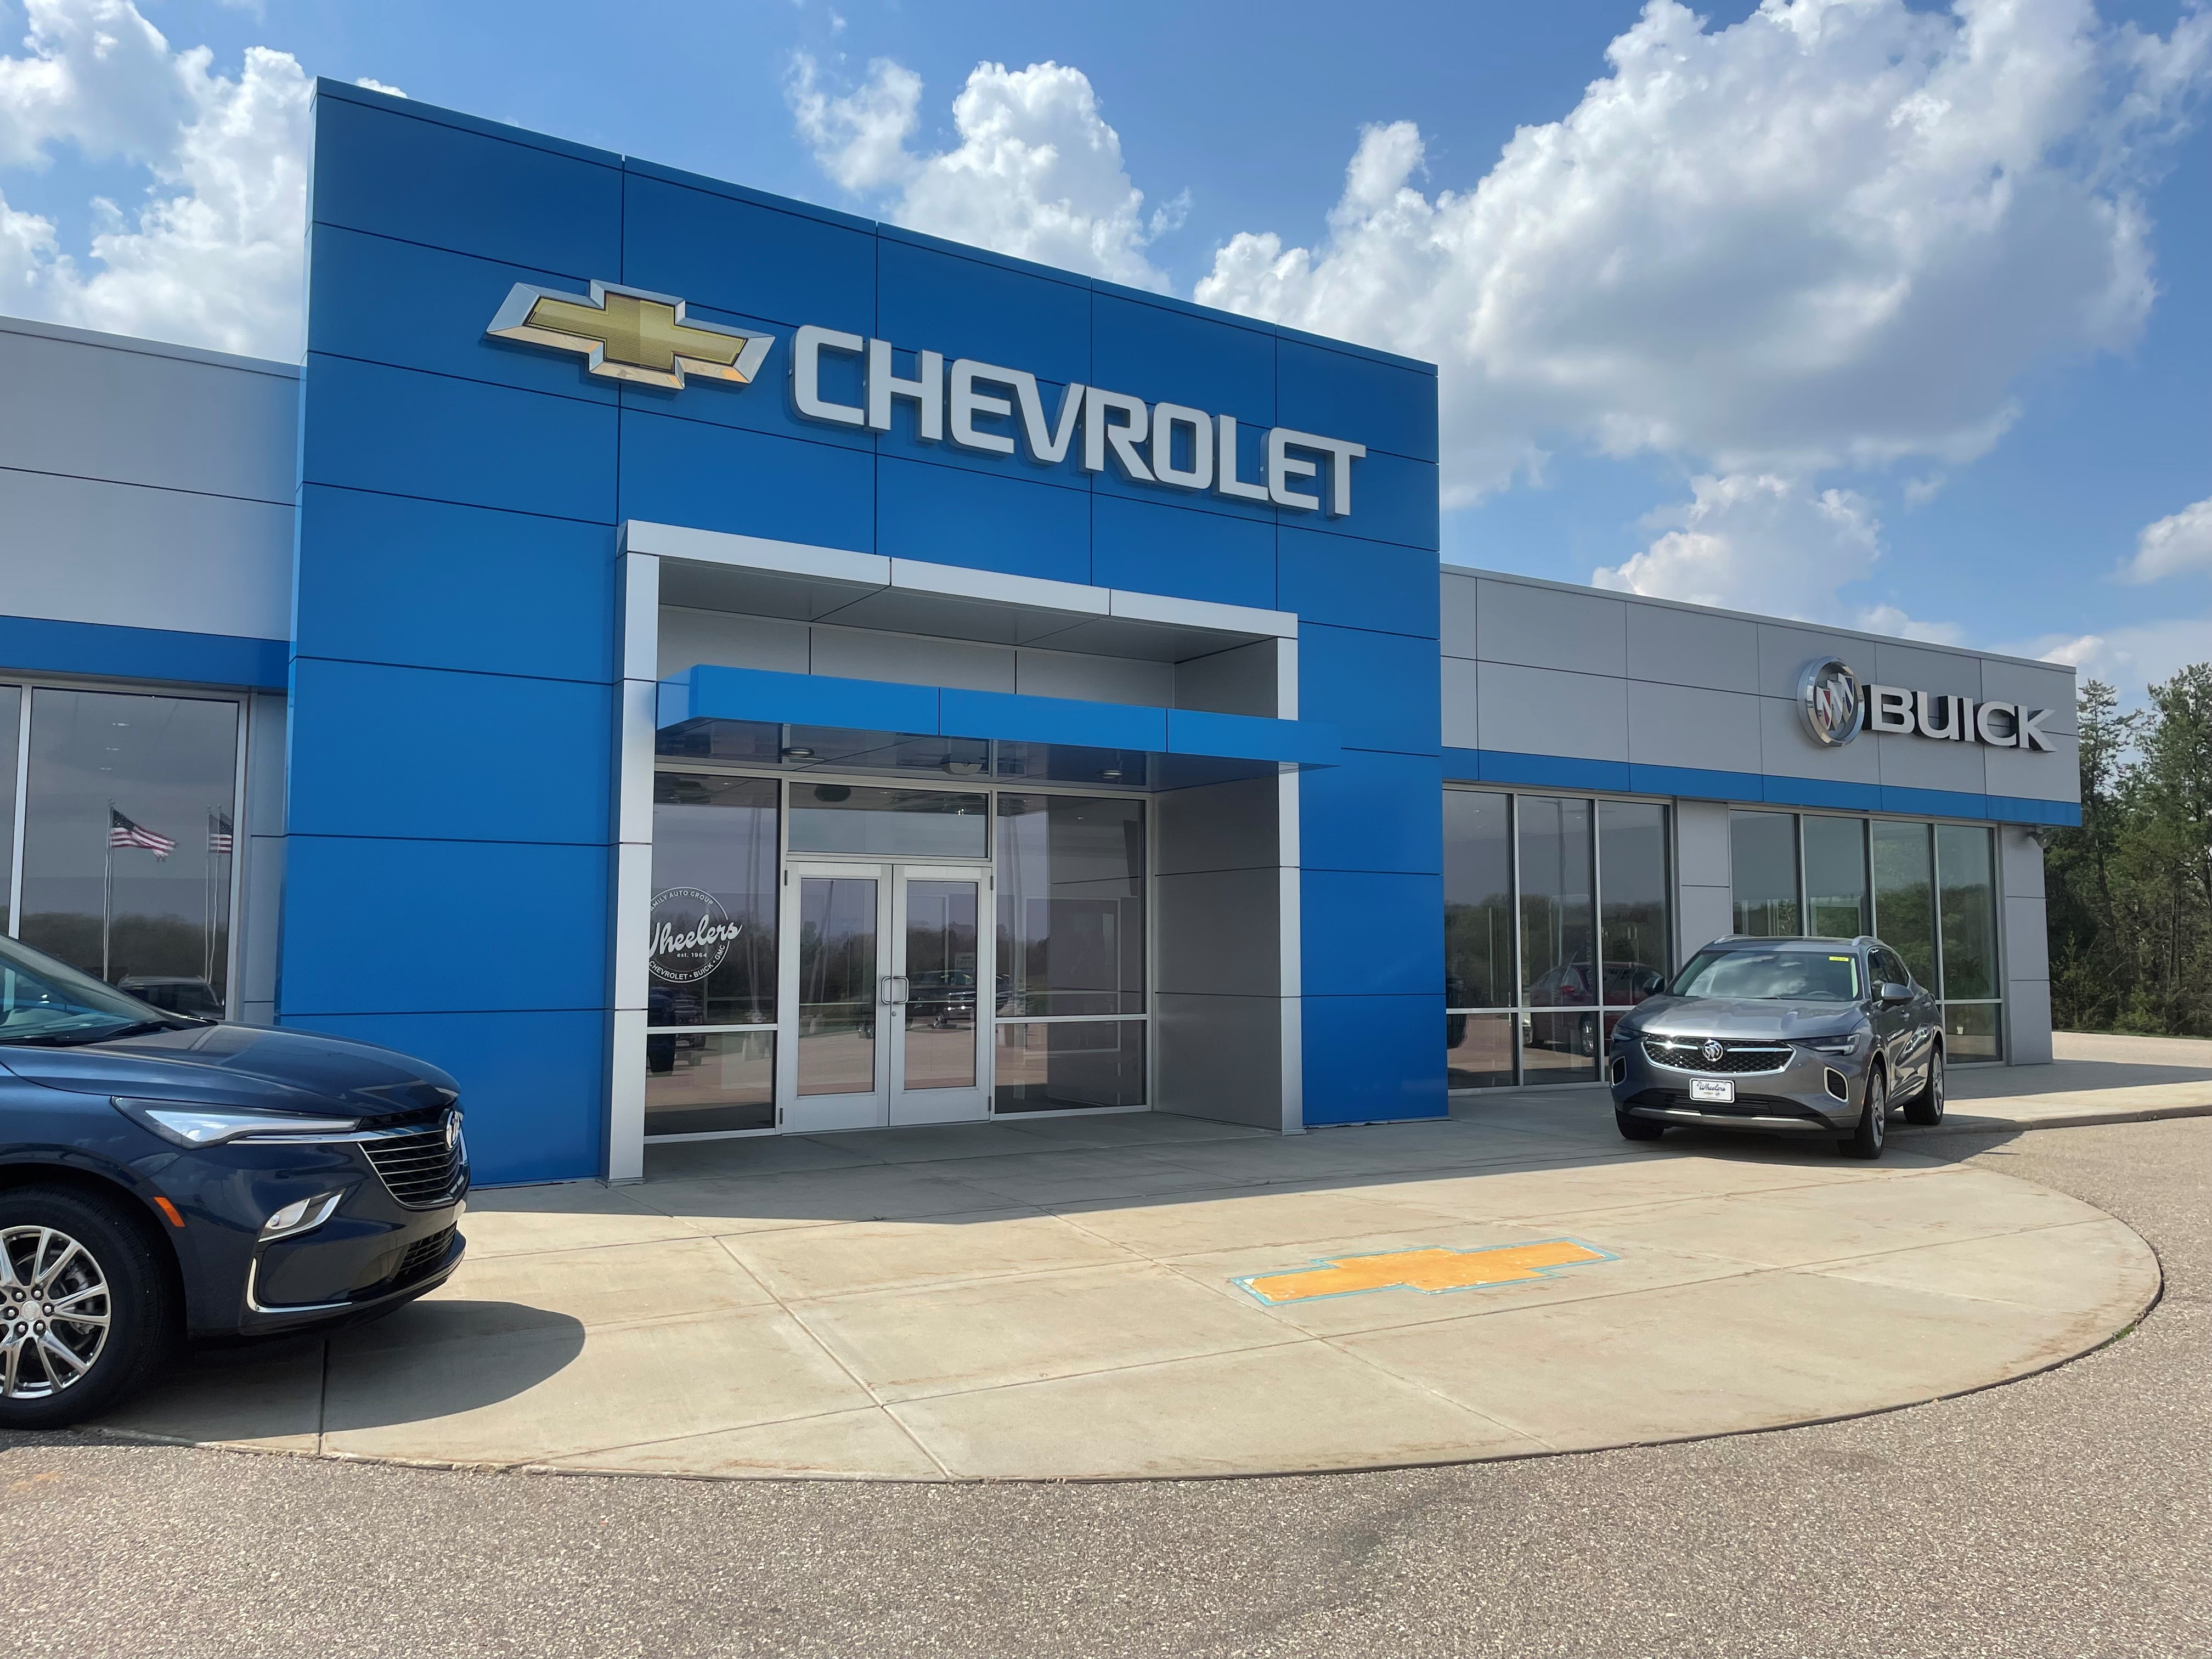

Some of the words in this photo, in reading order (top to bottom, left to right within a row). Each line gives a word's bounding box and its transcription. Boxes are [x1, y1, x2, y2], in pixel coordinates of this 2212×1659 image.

[789, 325, 1367, 518] CHEVROLET
[1863, 684, 2057, 752] BUICK
[651, 894, 667, 911] AMILY
[690, 891, 713, 905] GROUP
[649, 961, 688, 980] CHEVROLET
[693, 962, 714, 978] BUICK
[714, 944, 725, 960] GMC
[1696, 1082, 1726, 1091] Wheelers
